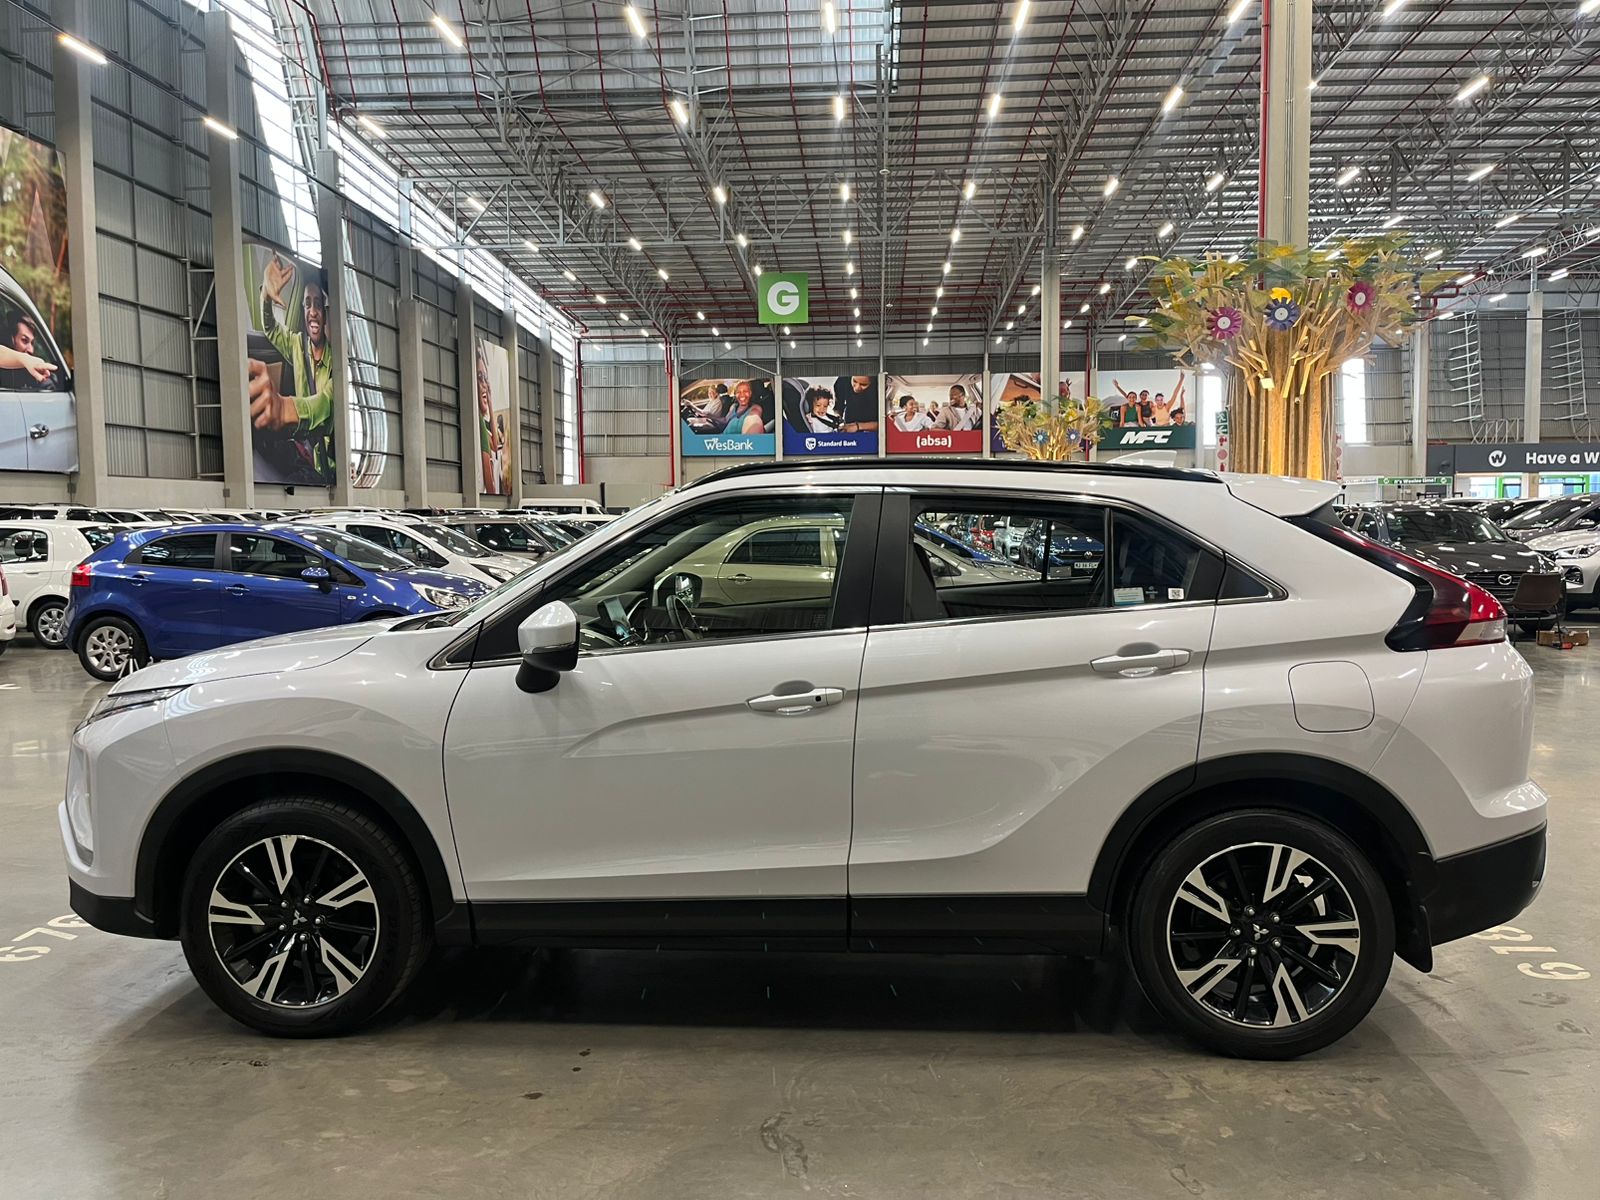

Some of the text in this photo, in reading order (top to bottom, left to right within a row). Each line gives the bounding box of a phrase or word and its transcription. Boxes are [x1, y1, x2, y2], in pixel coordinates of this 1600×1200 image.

[767, 281, 800, 316] G
[704, 437, 754, 451] WesBank
[916, 435, 952, 448] (absa)
[1119, 430, 1173, 445] MFC
[1526, 451, 1600, 465] Have a W
